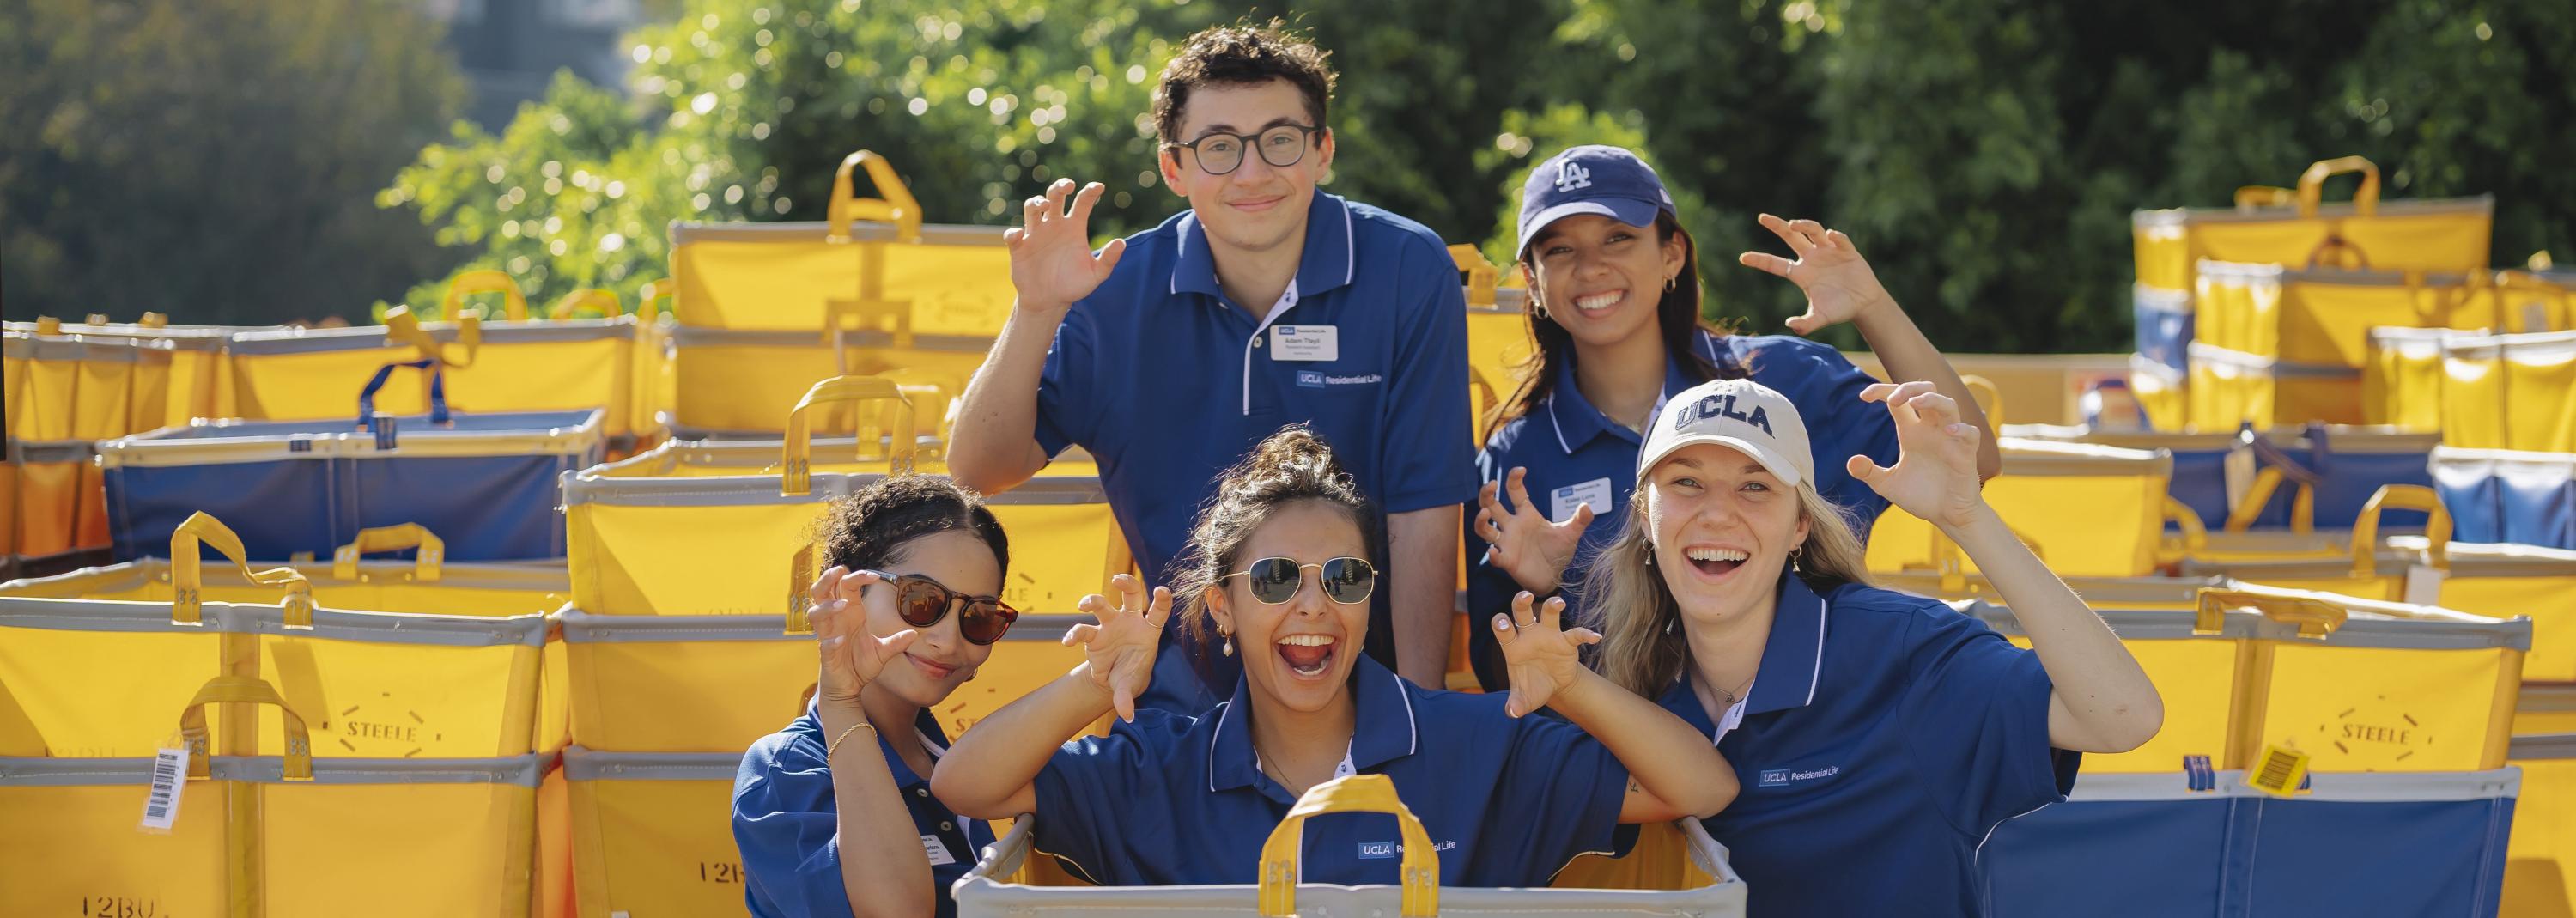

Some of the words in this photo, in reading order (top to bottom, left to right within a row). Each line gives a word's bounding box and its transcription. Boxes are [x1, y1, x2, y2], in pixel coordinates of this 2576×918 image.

[1555, 157, 1592, 192] LA
[1300, 374, 1322, 384] UCLA
[1325, 374, 1366, 385] Residential
[1367, 374, 1382, 383] Life
[1675, 394, 1776, 439] UCLA
[347, 720, 416, 744] STEELE
[2342, 724, 2410, 745] STEELE
[1764, 772, 1787, 782] UCLA
[1791, 768, 1828, 781] Residential
[1828, 765, 1839, 775] Life
[1364, 844, 1390, 854] UCLA
[1442, 841, 1456, 850] Life
